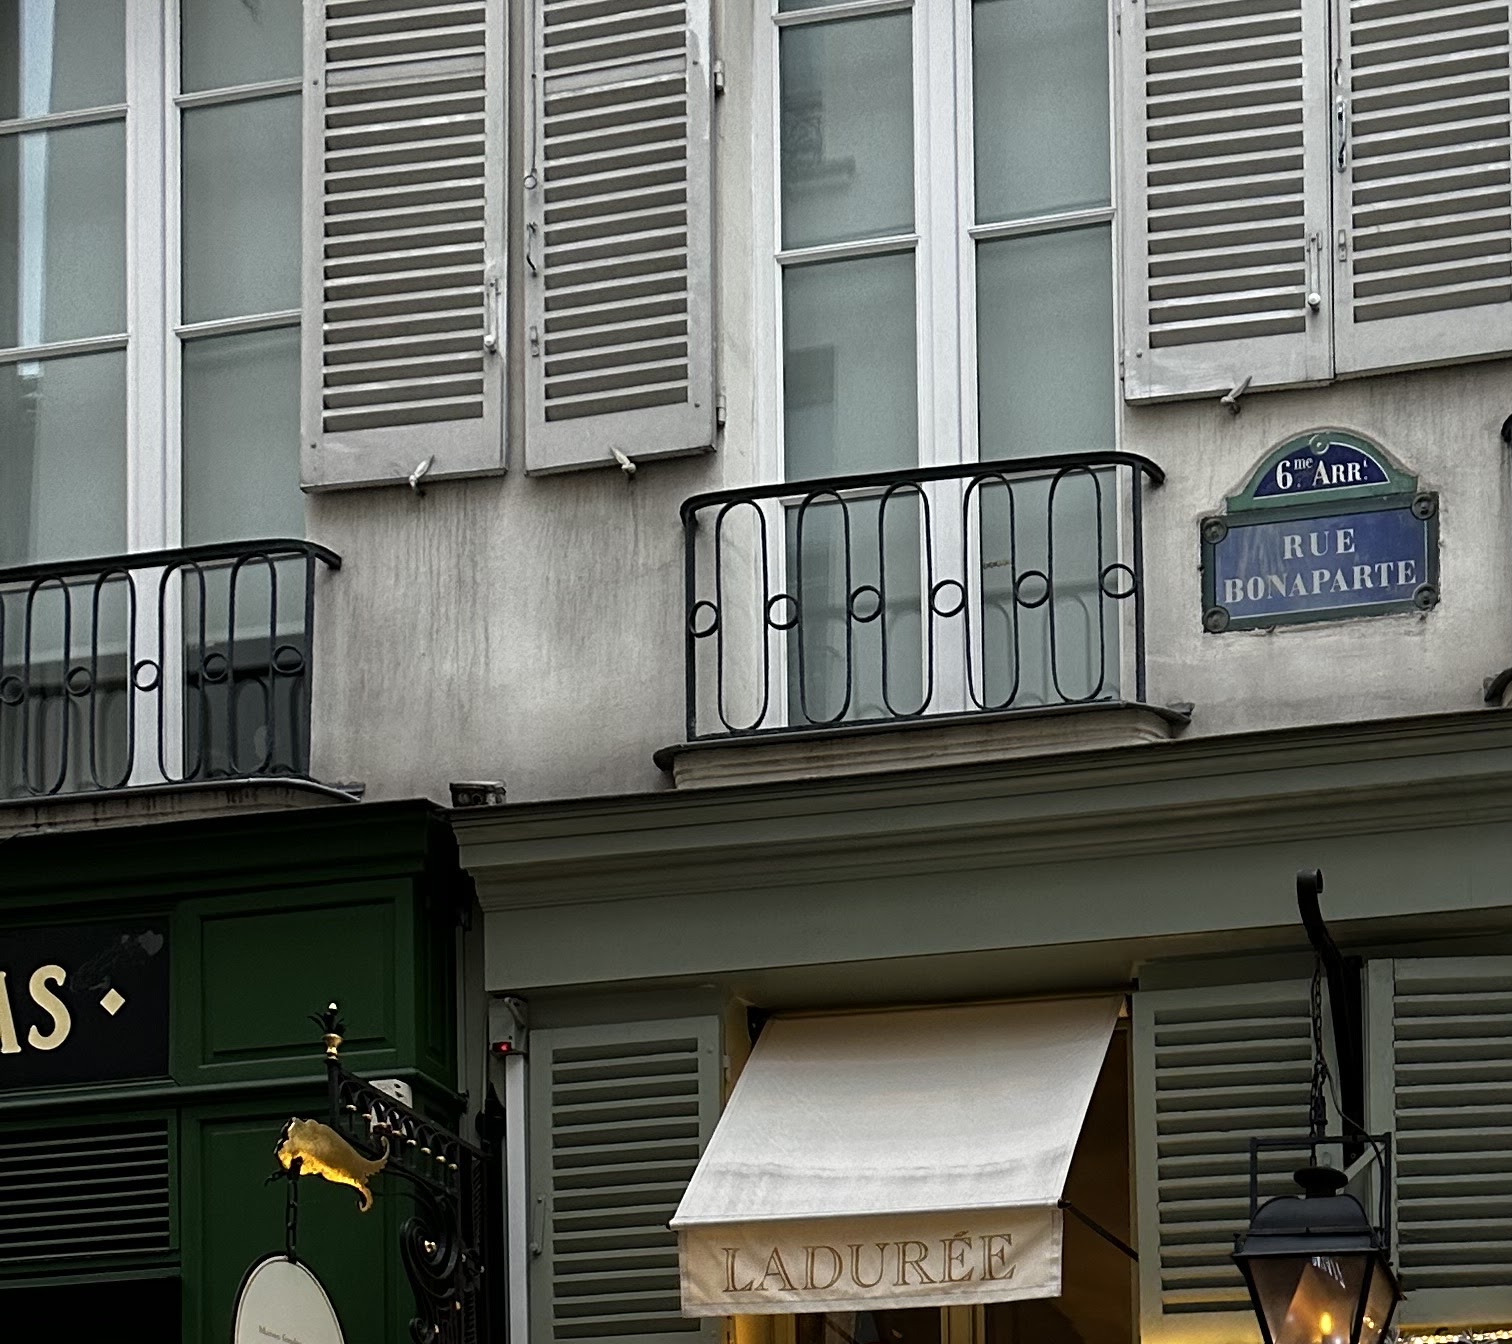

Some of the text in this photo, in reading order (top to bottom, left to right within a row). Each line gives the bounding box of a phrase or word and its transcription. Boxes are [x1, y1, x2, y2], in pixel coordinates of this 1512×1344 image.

[1283, 528, 1356, 560] RUE
[1224, 560, 1417, 604] BONAPARTE
[721, 1230, 1017, 1293] LADURÉE
